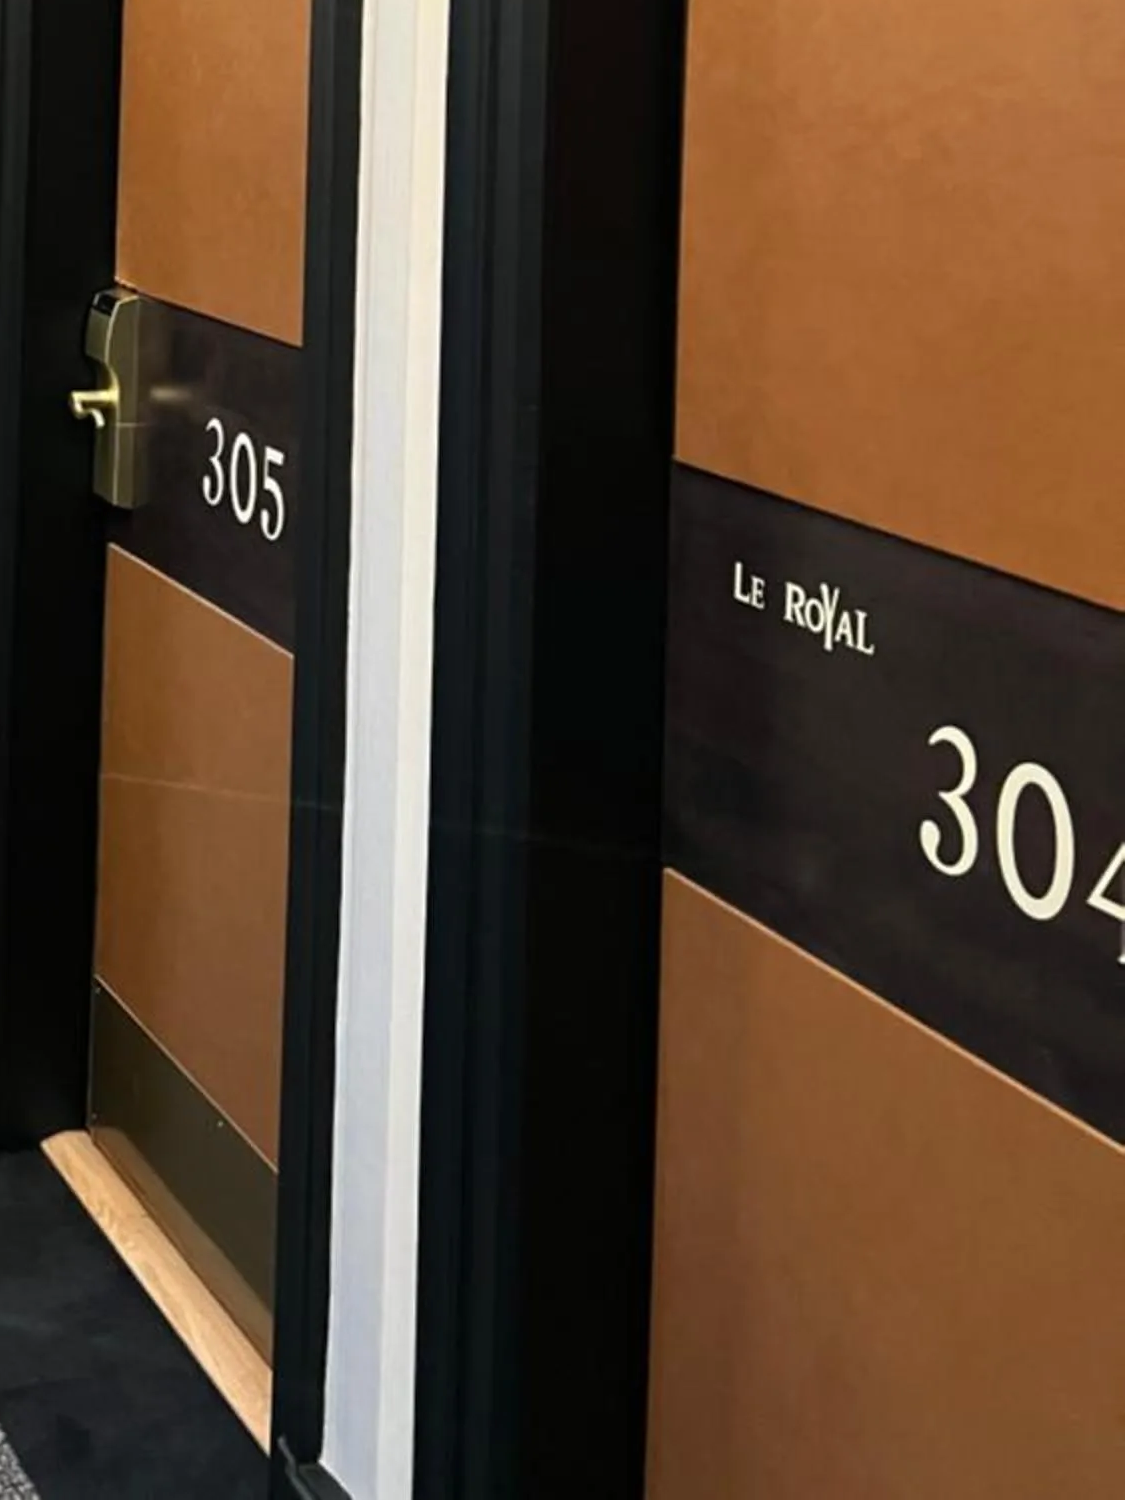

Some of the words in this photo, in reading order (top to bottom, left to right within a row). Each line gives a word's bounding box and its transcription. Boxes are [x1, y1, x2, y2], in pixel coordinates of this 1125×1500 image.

[202, 417, 285, 541] 305
[733, 561, 765, 610] LE
[783, 582, 875, 656] ROYAL
